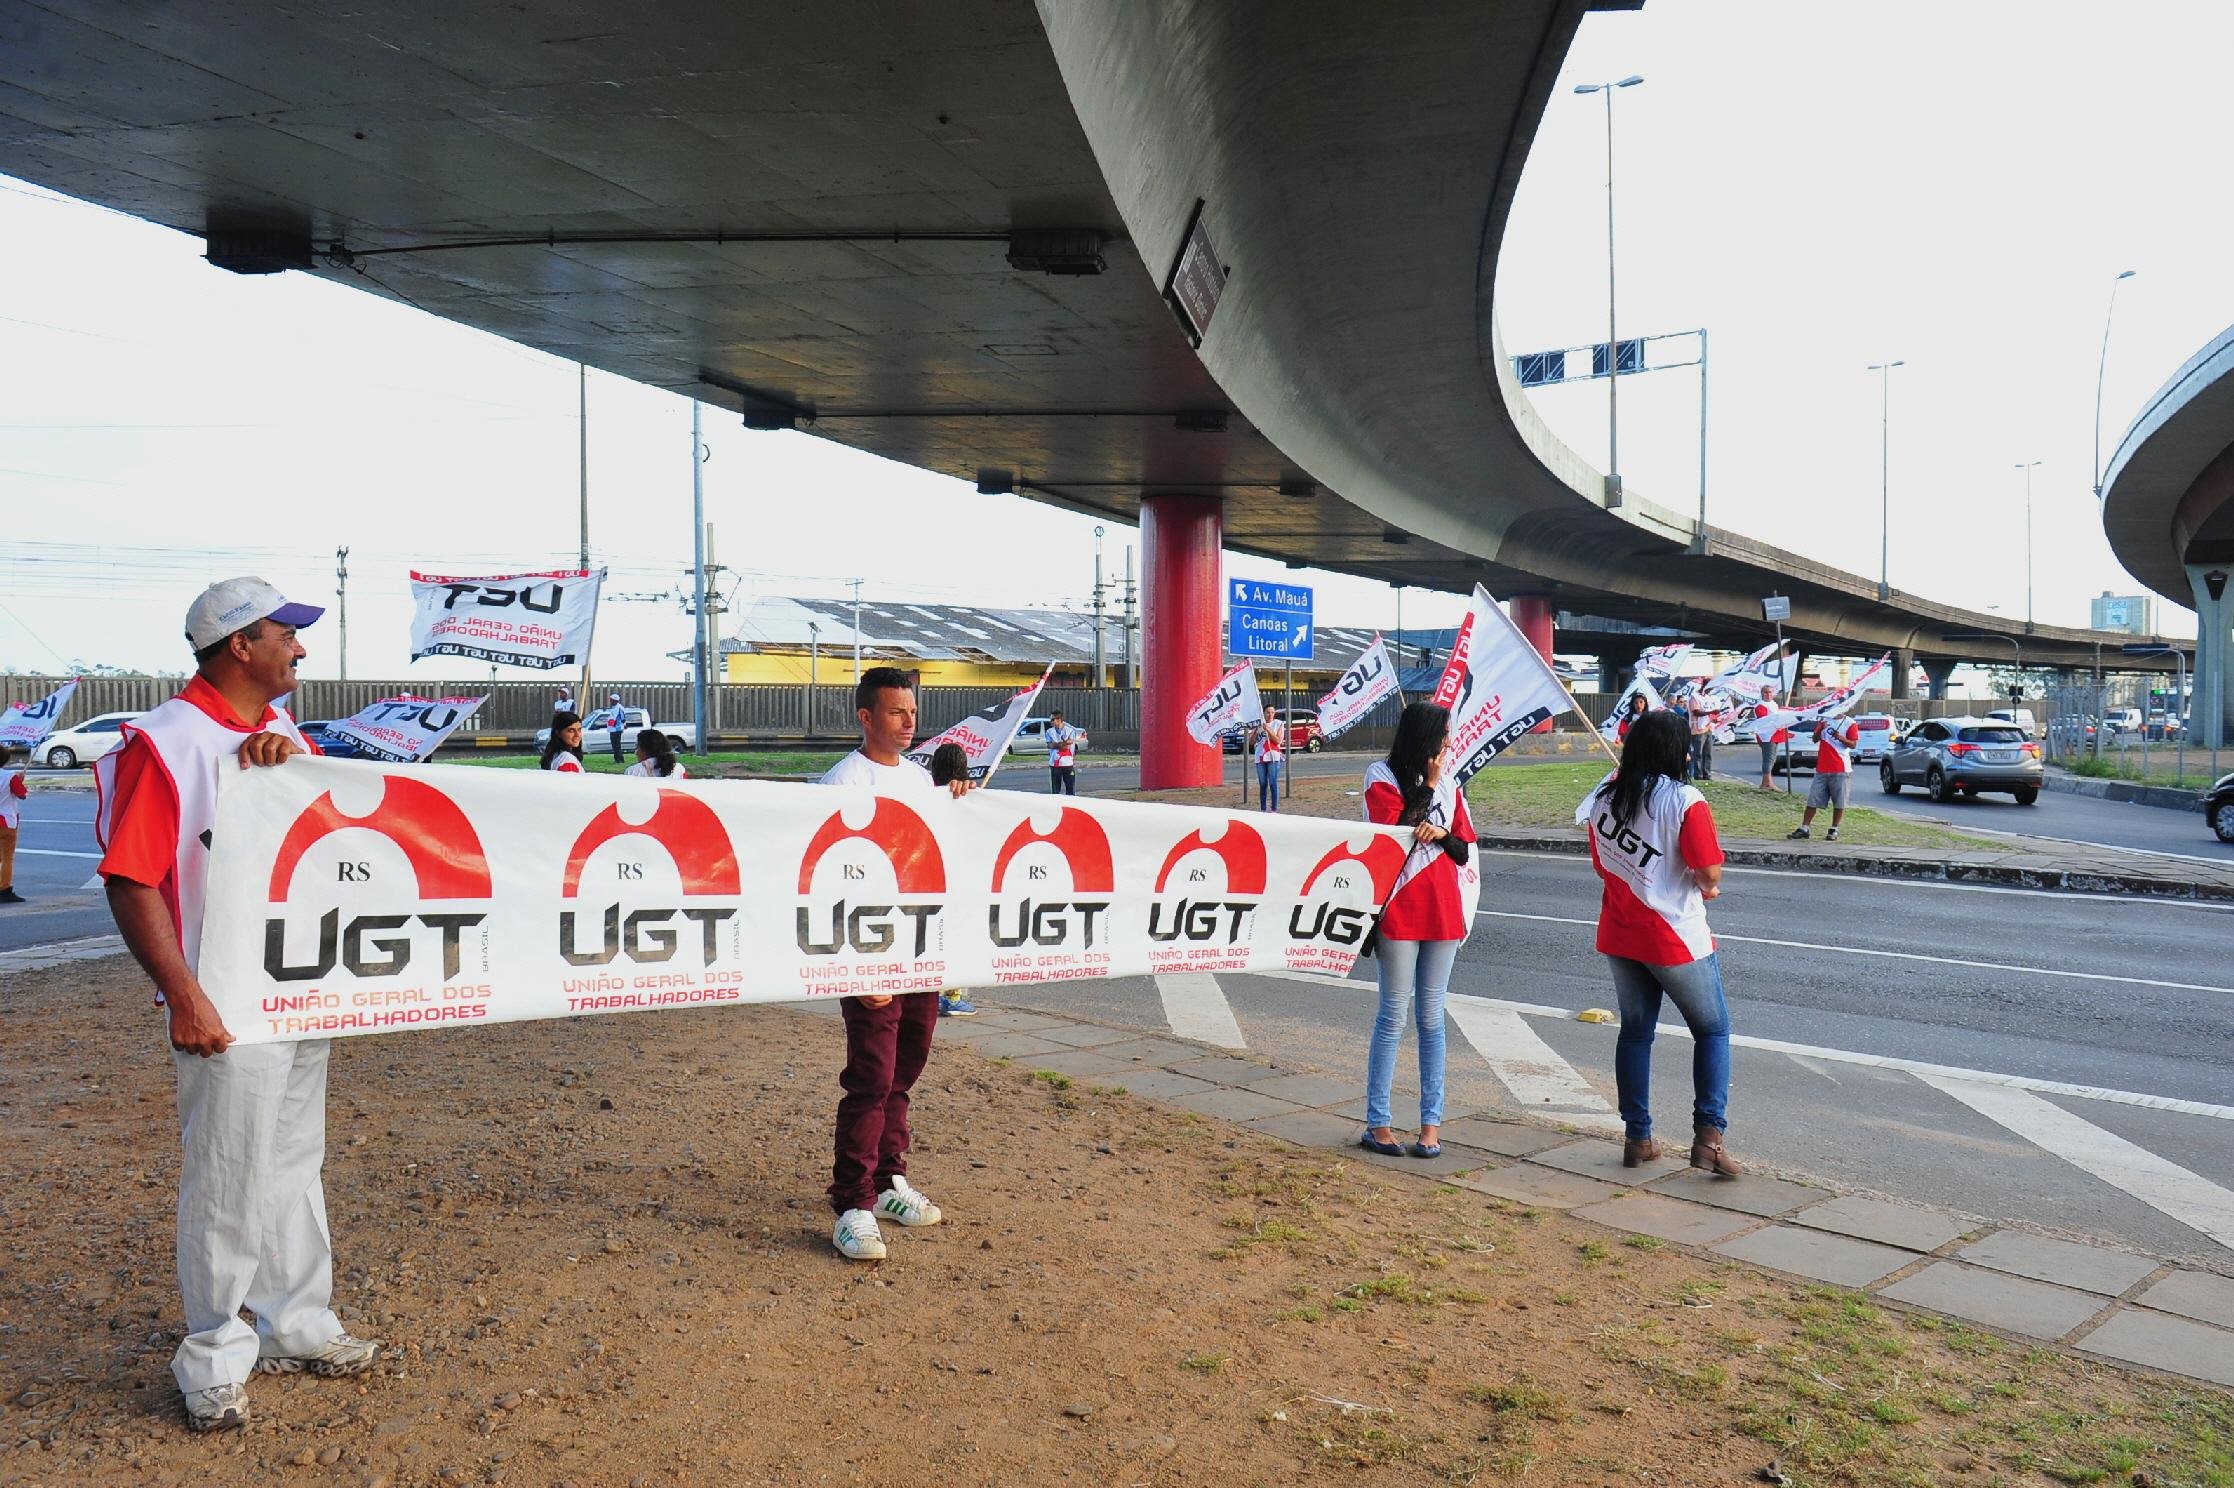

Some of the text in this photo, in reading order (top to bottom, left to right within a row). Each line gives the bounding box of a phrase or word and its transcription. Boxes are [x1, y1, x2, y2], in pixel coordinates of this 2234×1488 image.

[1253, 587, 1308, 607] Av. Mauá
[1242, 614, 1288, 632] Canoas
[1249, 635, 1288, 652] Litoral
[1597, 812, 1664, 868] UGT
[336, 861, 372, 882] RS
[617, 862, 643, 880] RS
[843, 864, 865, 880] RS
[1028, 865, 1047, 880] RS
[1188, 868, 1207, 882] RS
[1333, 875, 1351, 889] RS
[796, 898, 944, 959] UGT
[989, 896, 1111, 950] UGT
[1147, 896, 1259, 946] UGT
[264, 907, 488, 982] UGT
[559, 901, 738, 969] UGT
[481, 925, 490, 973] BRASIL
[1148, 946, 1250, 961] UNIÃO GERAL DOS
[1285, 944, 1317, 957] UNIÃO
[799, 960, 946, 979] UNIÃO GERAL DOS
[992, 953, 1111, 969] UNIÃO GERAL DOS
[1151, 960, 1247, 974] TRABALHADORES
[562, 970, 744, 993] UNIÃO GERAL DOS
[994, 966, 1108, 983] TRABALHADORES
[804, 975, 943, 995] TRABALHADORES
[262, 984, 493, 1013] UNIÃO GERAL DOS
[567, 987, 741, 1012] TRABALHADORES
[267, 1004, 488, 1035] TRABALHADORES
